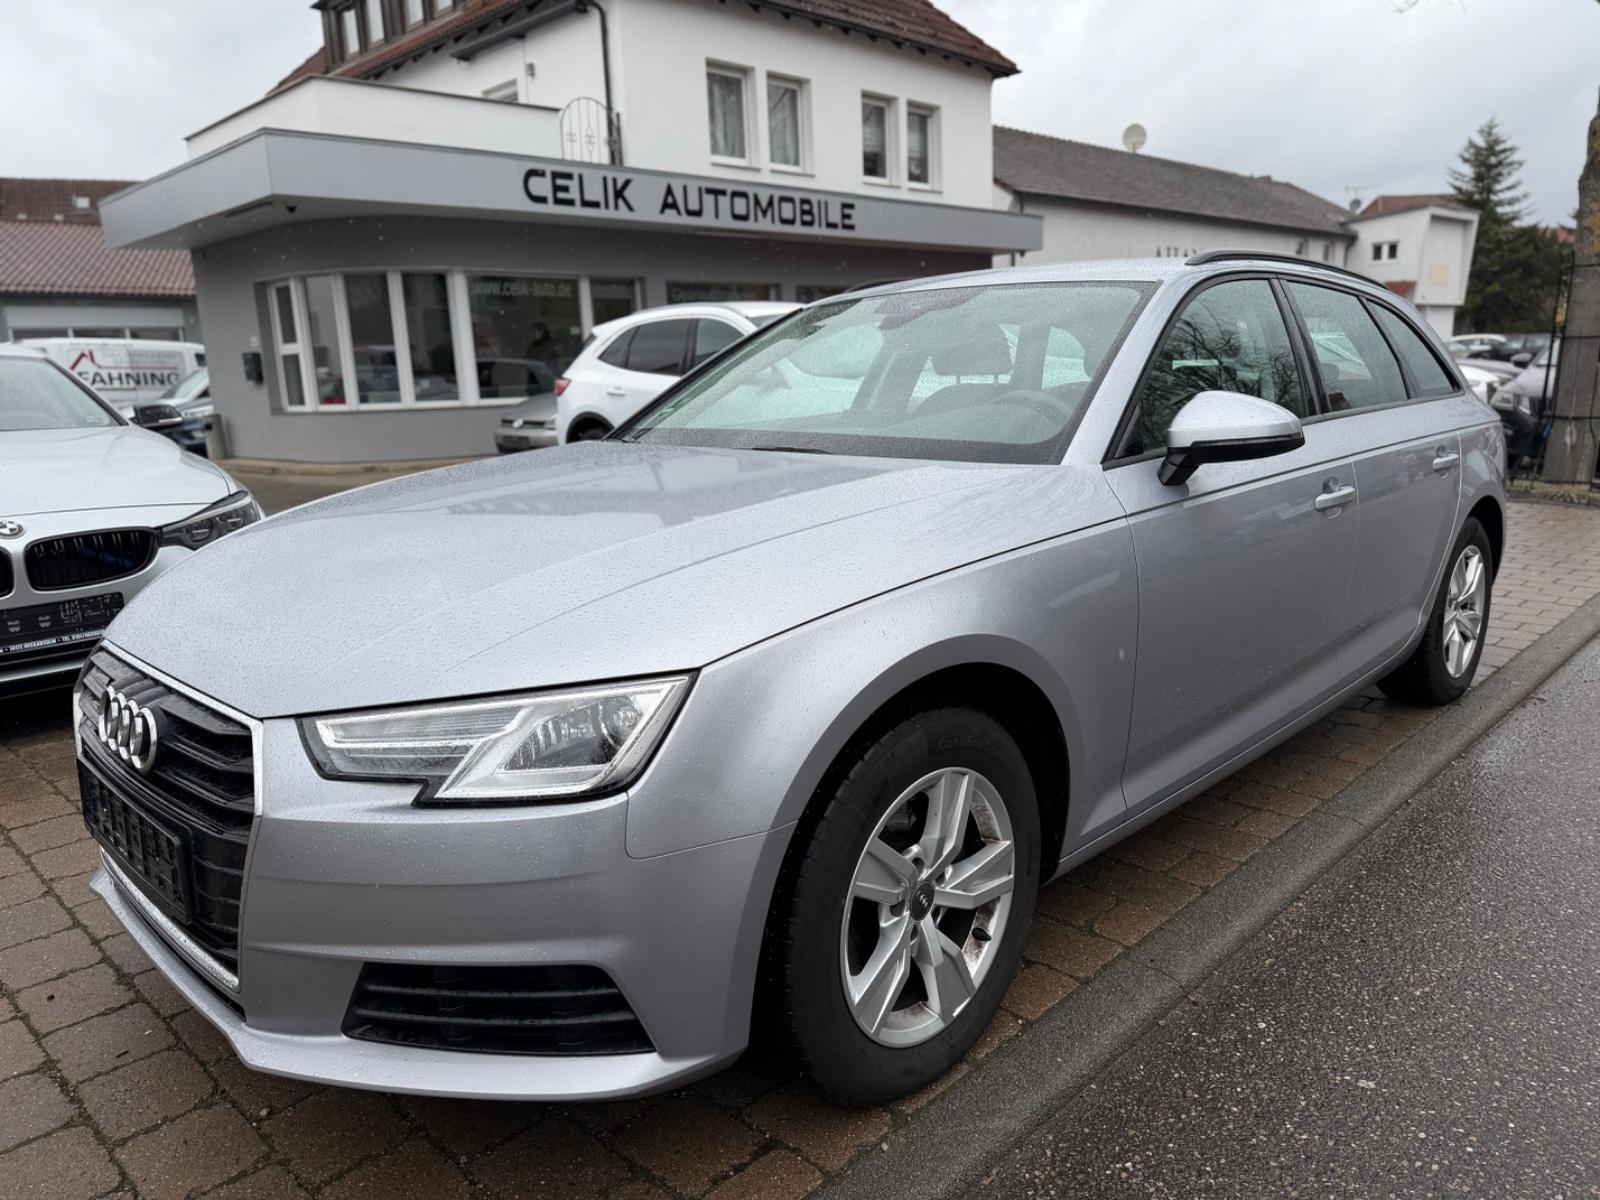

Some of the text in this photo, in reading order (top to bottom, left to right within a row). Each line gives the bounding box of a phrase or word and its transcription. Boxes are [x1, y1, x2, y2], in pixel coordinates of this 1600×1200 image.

[523, 168, 856, 231] CELIK AUTOMOBILE
[78, 371, 180, 386] FAHNING
